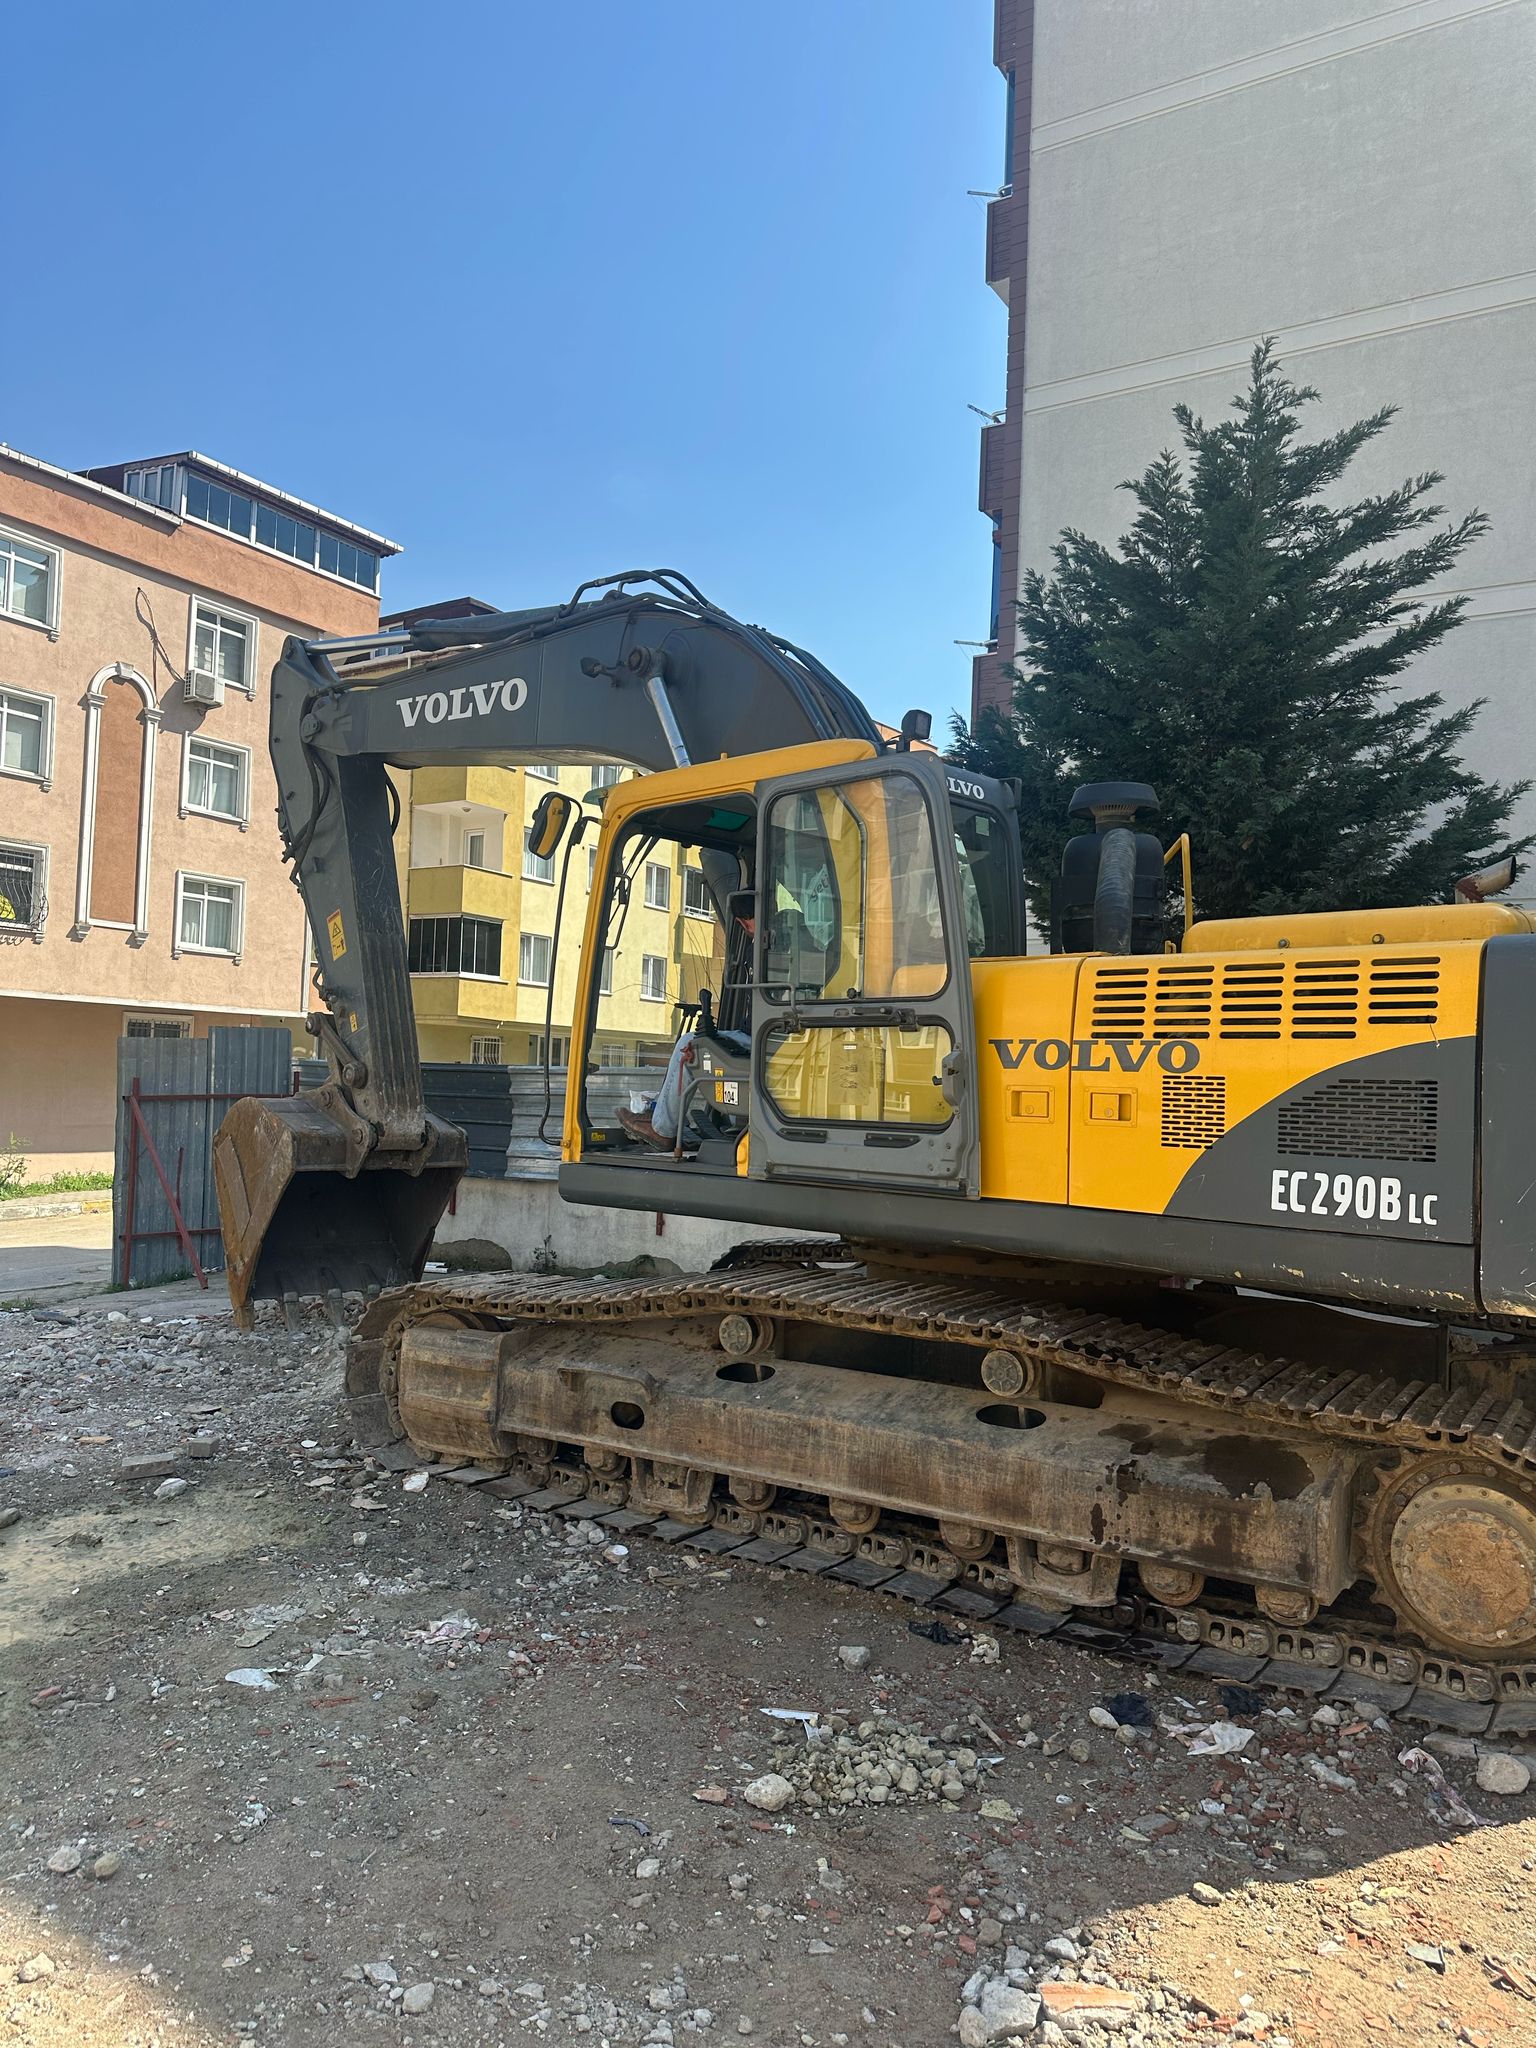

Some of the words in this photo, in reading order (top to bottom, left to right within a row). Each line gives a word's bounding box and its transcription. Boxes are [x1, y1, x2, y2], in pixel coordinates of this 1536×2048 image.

[396, 678, 528, 728] VOLVO
[945, 776, 985, 800] LVO
[988, 1039, 1201, 1074] VOLVO
[1271, 1169, 1402, 1221] EC290B
[1408, 1193, 1438, 1226] LC
